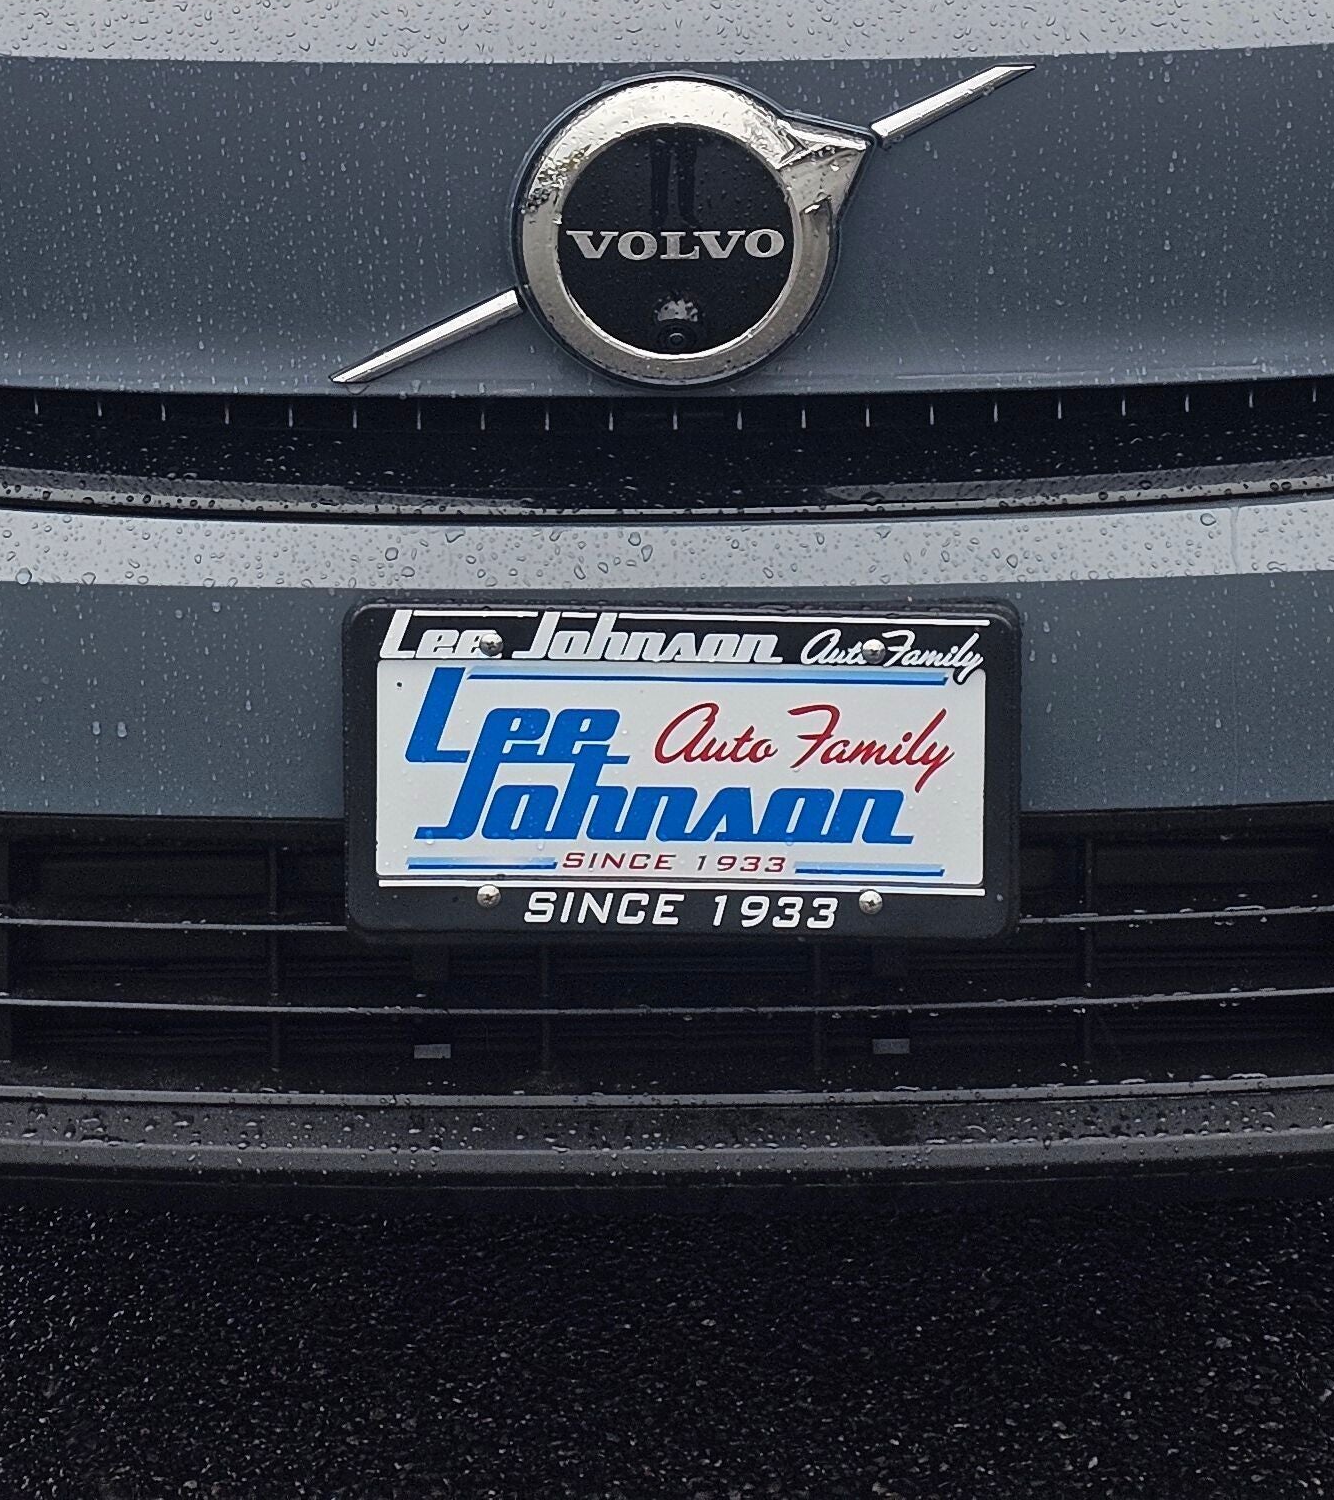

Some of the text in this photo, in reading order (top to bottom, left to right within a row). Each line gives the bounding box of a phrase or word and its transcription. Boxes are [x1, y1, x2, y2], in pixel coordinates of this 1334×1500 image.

[566, 228, 785, 260] VOLVO
[511, 610, 783, 663] Johnson
[800, 628, 875, 665] Aut
[881, 629, 984, 683] Family
[405, 667, 630, 765] Lee
[654, 702, 956, 793] Auto Family
[414, 762, 915, 845] Johnson
[562, 851, 788, 874] SINCE 1933
[523, 891, 839, 930] SINCE 1933
